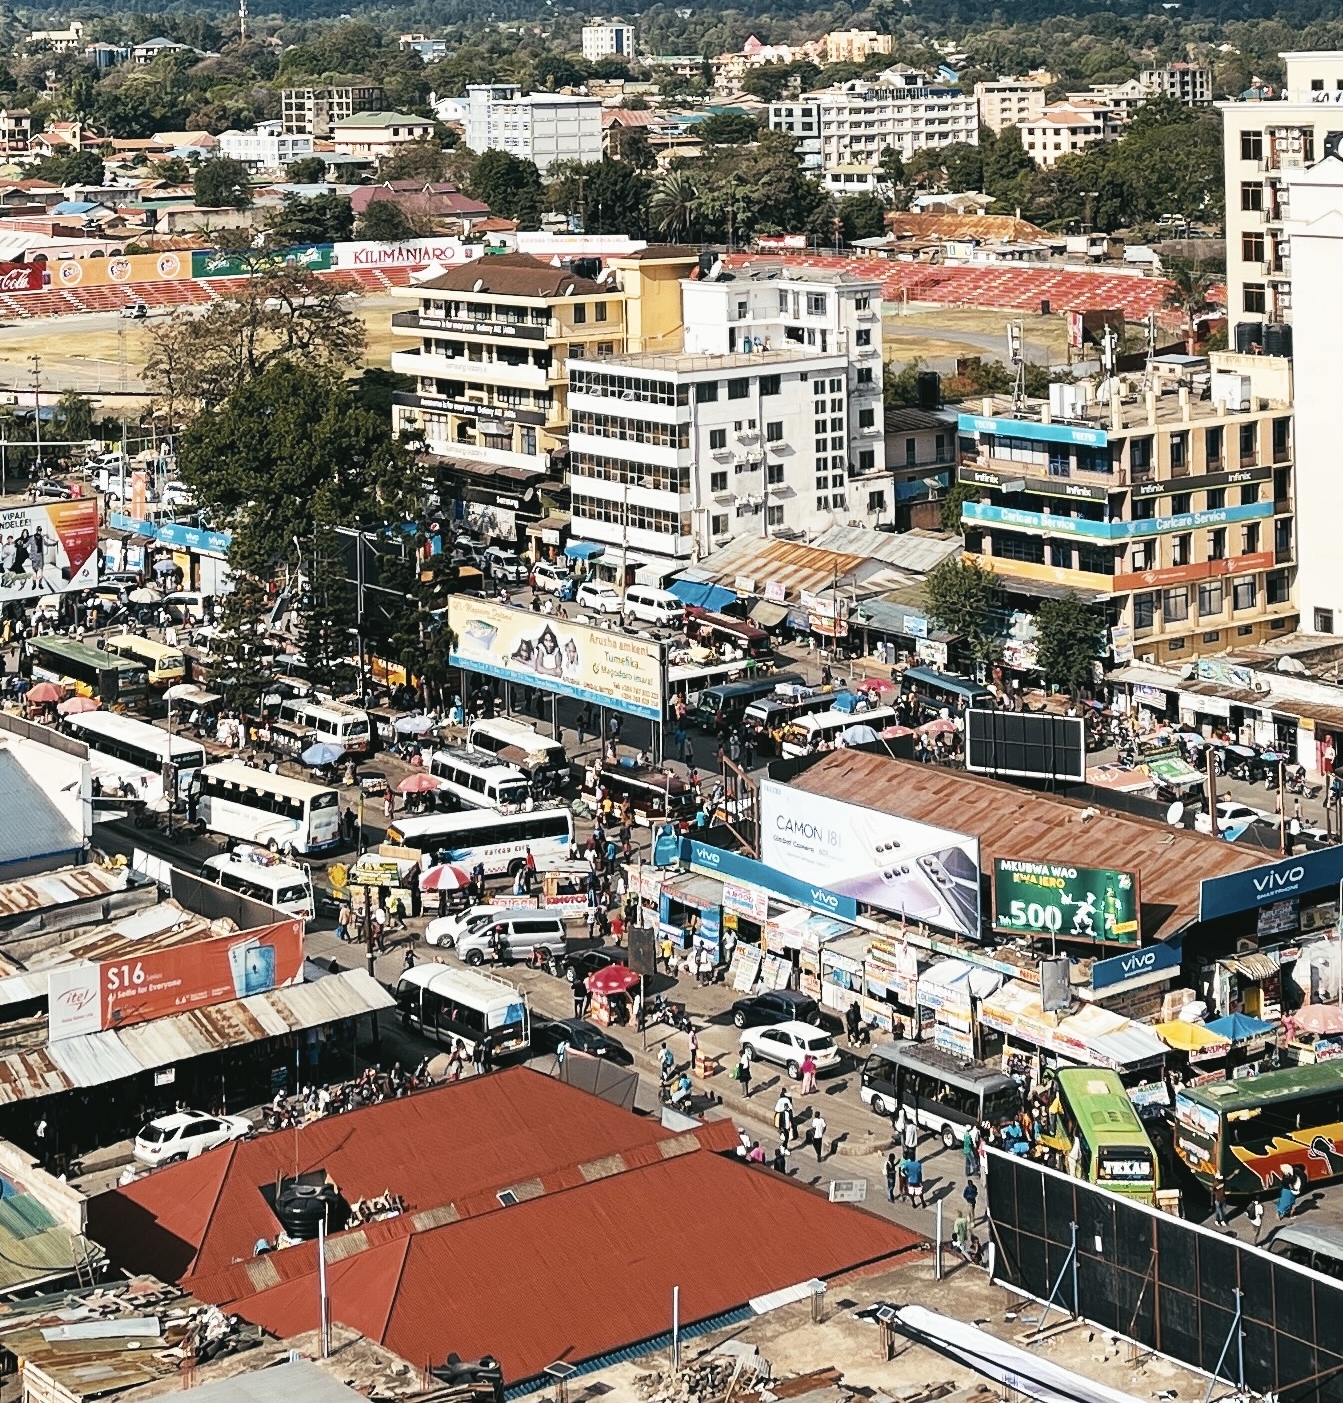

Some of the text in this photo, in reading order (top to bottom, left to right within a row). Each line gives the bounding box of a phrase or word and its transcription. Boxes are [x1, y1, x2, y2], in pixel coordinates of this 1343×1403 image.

[353, 246, 455, 265] KILIMANJARO
[974, 472, 999, 484] Infinix
[1228, 471, 1252, 482] Infinix
[1066, 485, 1092, 497] Infinix
[1140, 483, 1166, 494] Infinix
[1001, 510, 1076, 530] Caricare Service
[1156, 510, 1227, 530] Caricare Service
[589, 632, 618, 649] Arusha
[776, 814, 823, 842] CAMON
[696, 848, 720, 864] vivo
[1001, 859, 1078, 879] MKUBWA WAO
[1013, 872, 1038, 885] KWA
[1253, 865, 1305, 892] vivo
[810, 888, 839, 907] vivo
[1010, 899, 1062, 931] 500
[1121, 952, 1156, 972] vivo
[107, 962, 145, 989] S16
[65, 989, 90, 1004] itel
[138, 987, 148, 996] for
[149, 979, 182, 994] Everyone
